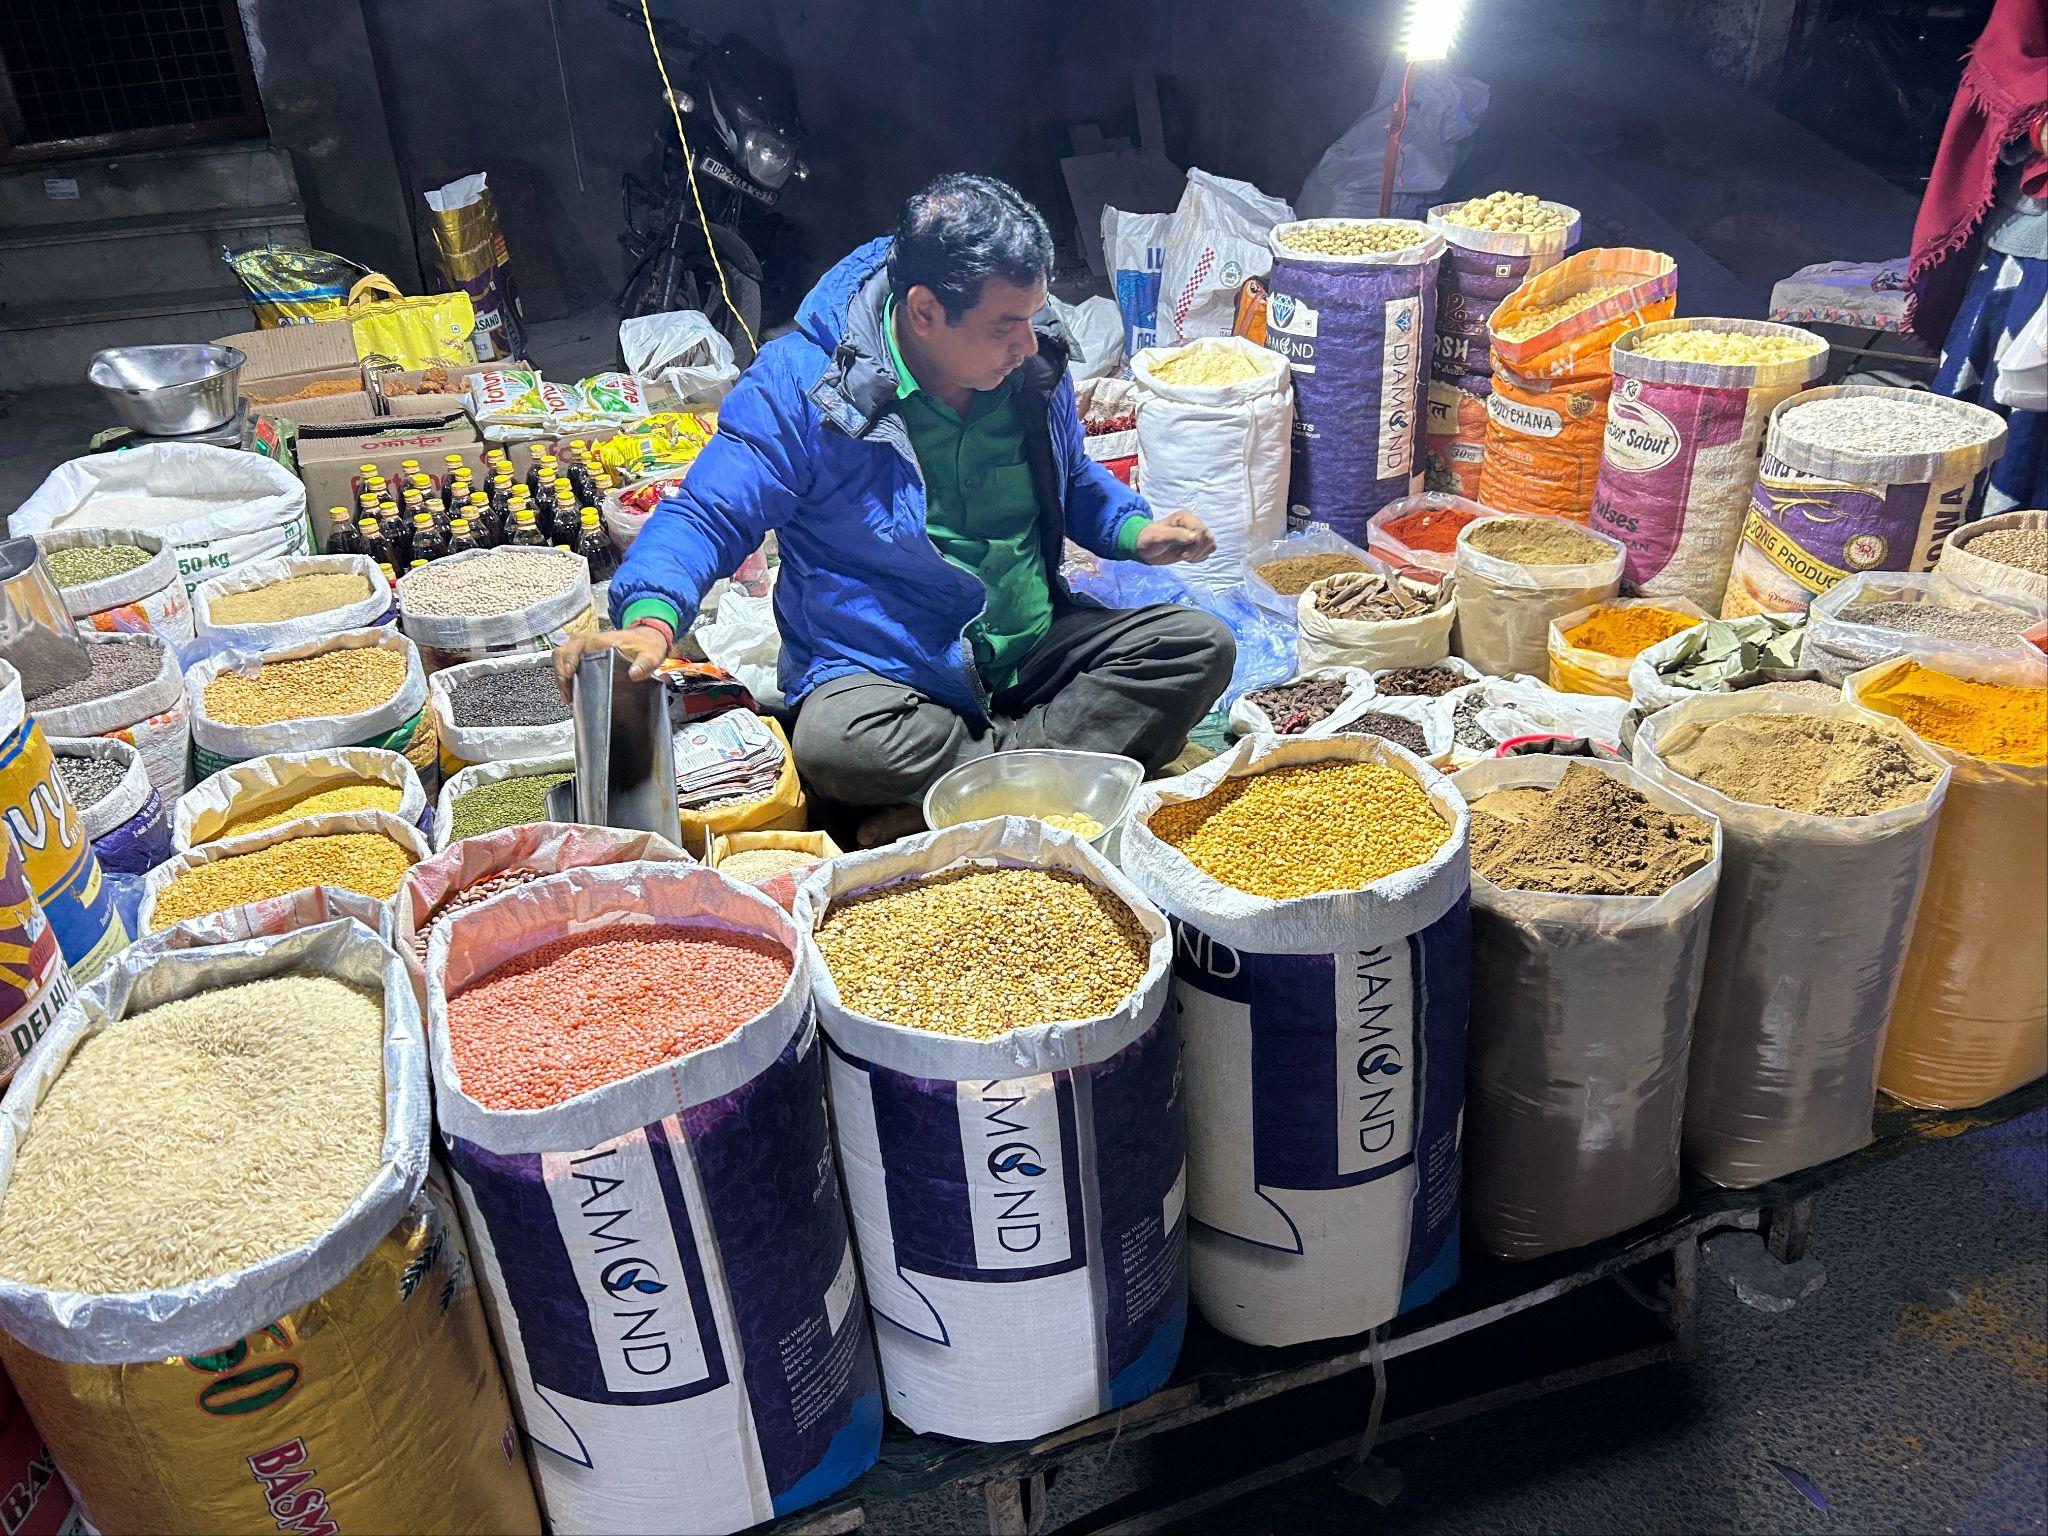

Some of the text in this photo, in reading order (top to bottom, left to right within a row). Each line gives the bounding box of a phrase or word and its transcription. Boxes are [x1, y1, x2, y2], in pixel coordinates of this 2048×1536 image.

[713, 164, 726, 176] UP
[474, 314, 500, 331] ASAND
[1432, 334, 1468, 362] ASH
[1626, 382, 1638, 396] RG
[1386, 344, 1410, 470] DIAMOND
[1510, 408, 1552, 430] CHANA
[1626, 428, 1670, 456] Sabut
[178, 552, 230, 576] 50 kg
[1178, 922, 1241, 978] ND
[570, 1148, 671, 1376] IAMOND
[1123, 1248, 1142, 1264] Packed
[1124, 1260, 1140, 1274] Batch
[779, 1318, 811, 1348] Net Weight
[796, 1326, 812, 1344] Retail
[784, 1352, 805, 1372] Packed
[786, 1366, 802, 1382] Batch
